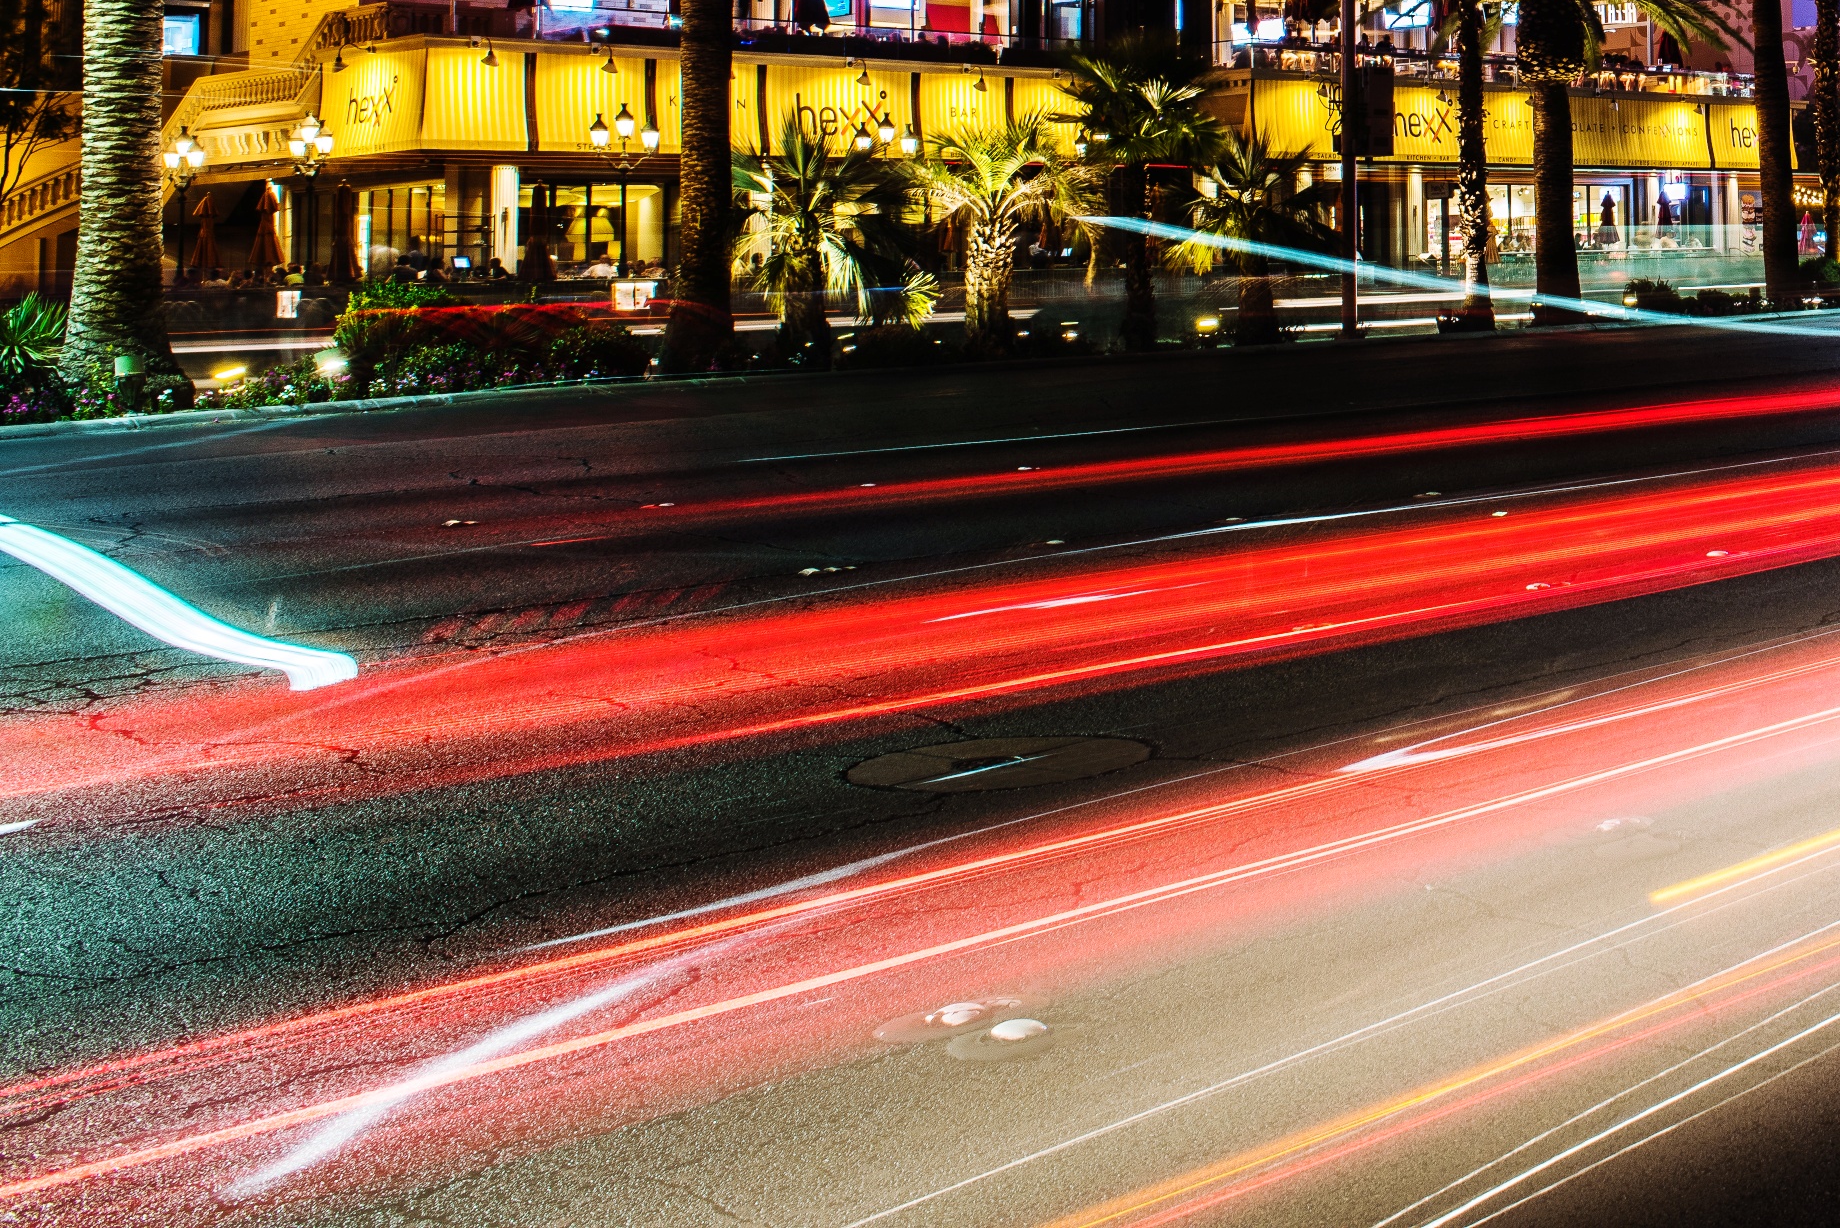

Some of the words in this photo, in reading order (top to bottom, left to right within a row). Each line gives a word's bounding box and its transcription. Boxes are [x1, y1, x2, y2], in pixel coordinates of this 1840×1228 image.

[950, 107, 978, 119] BAR
[1493, 119, 1529, 131] CRAFT
[1571, 122, 1604, 133] OLATE
[576, 142, 613, 151] STES
